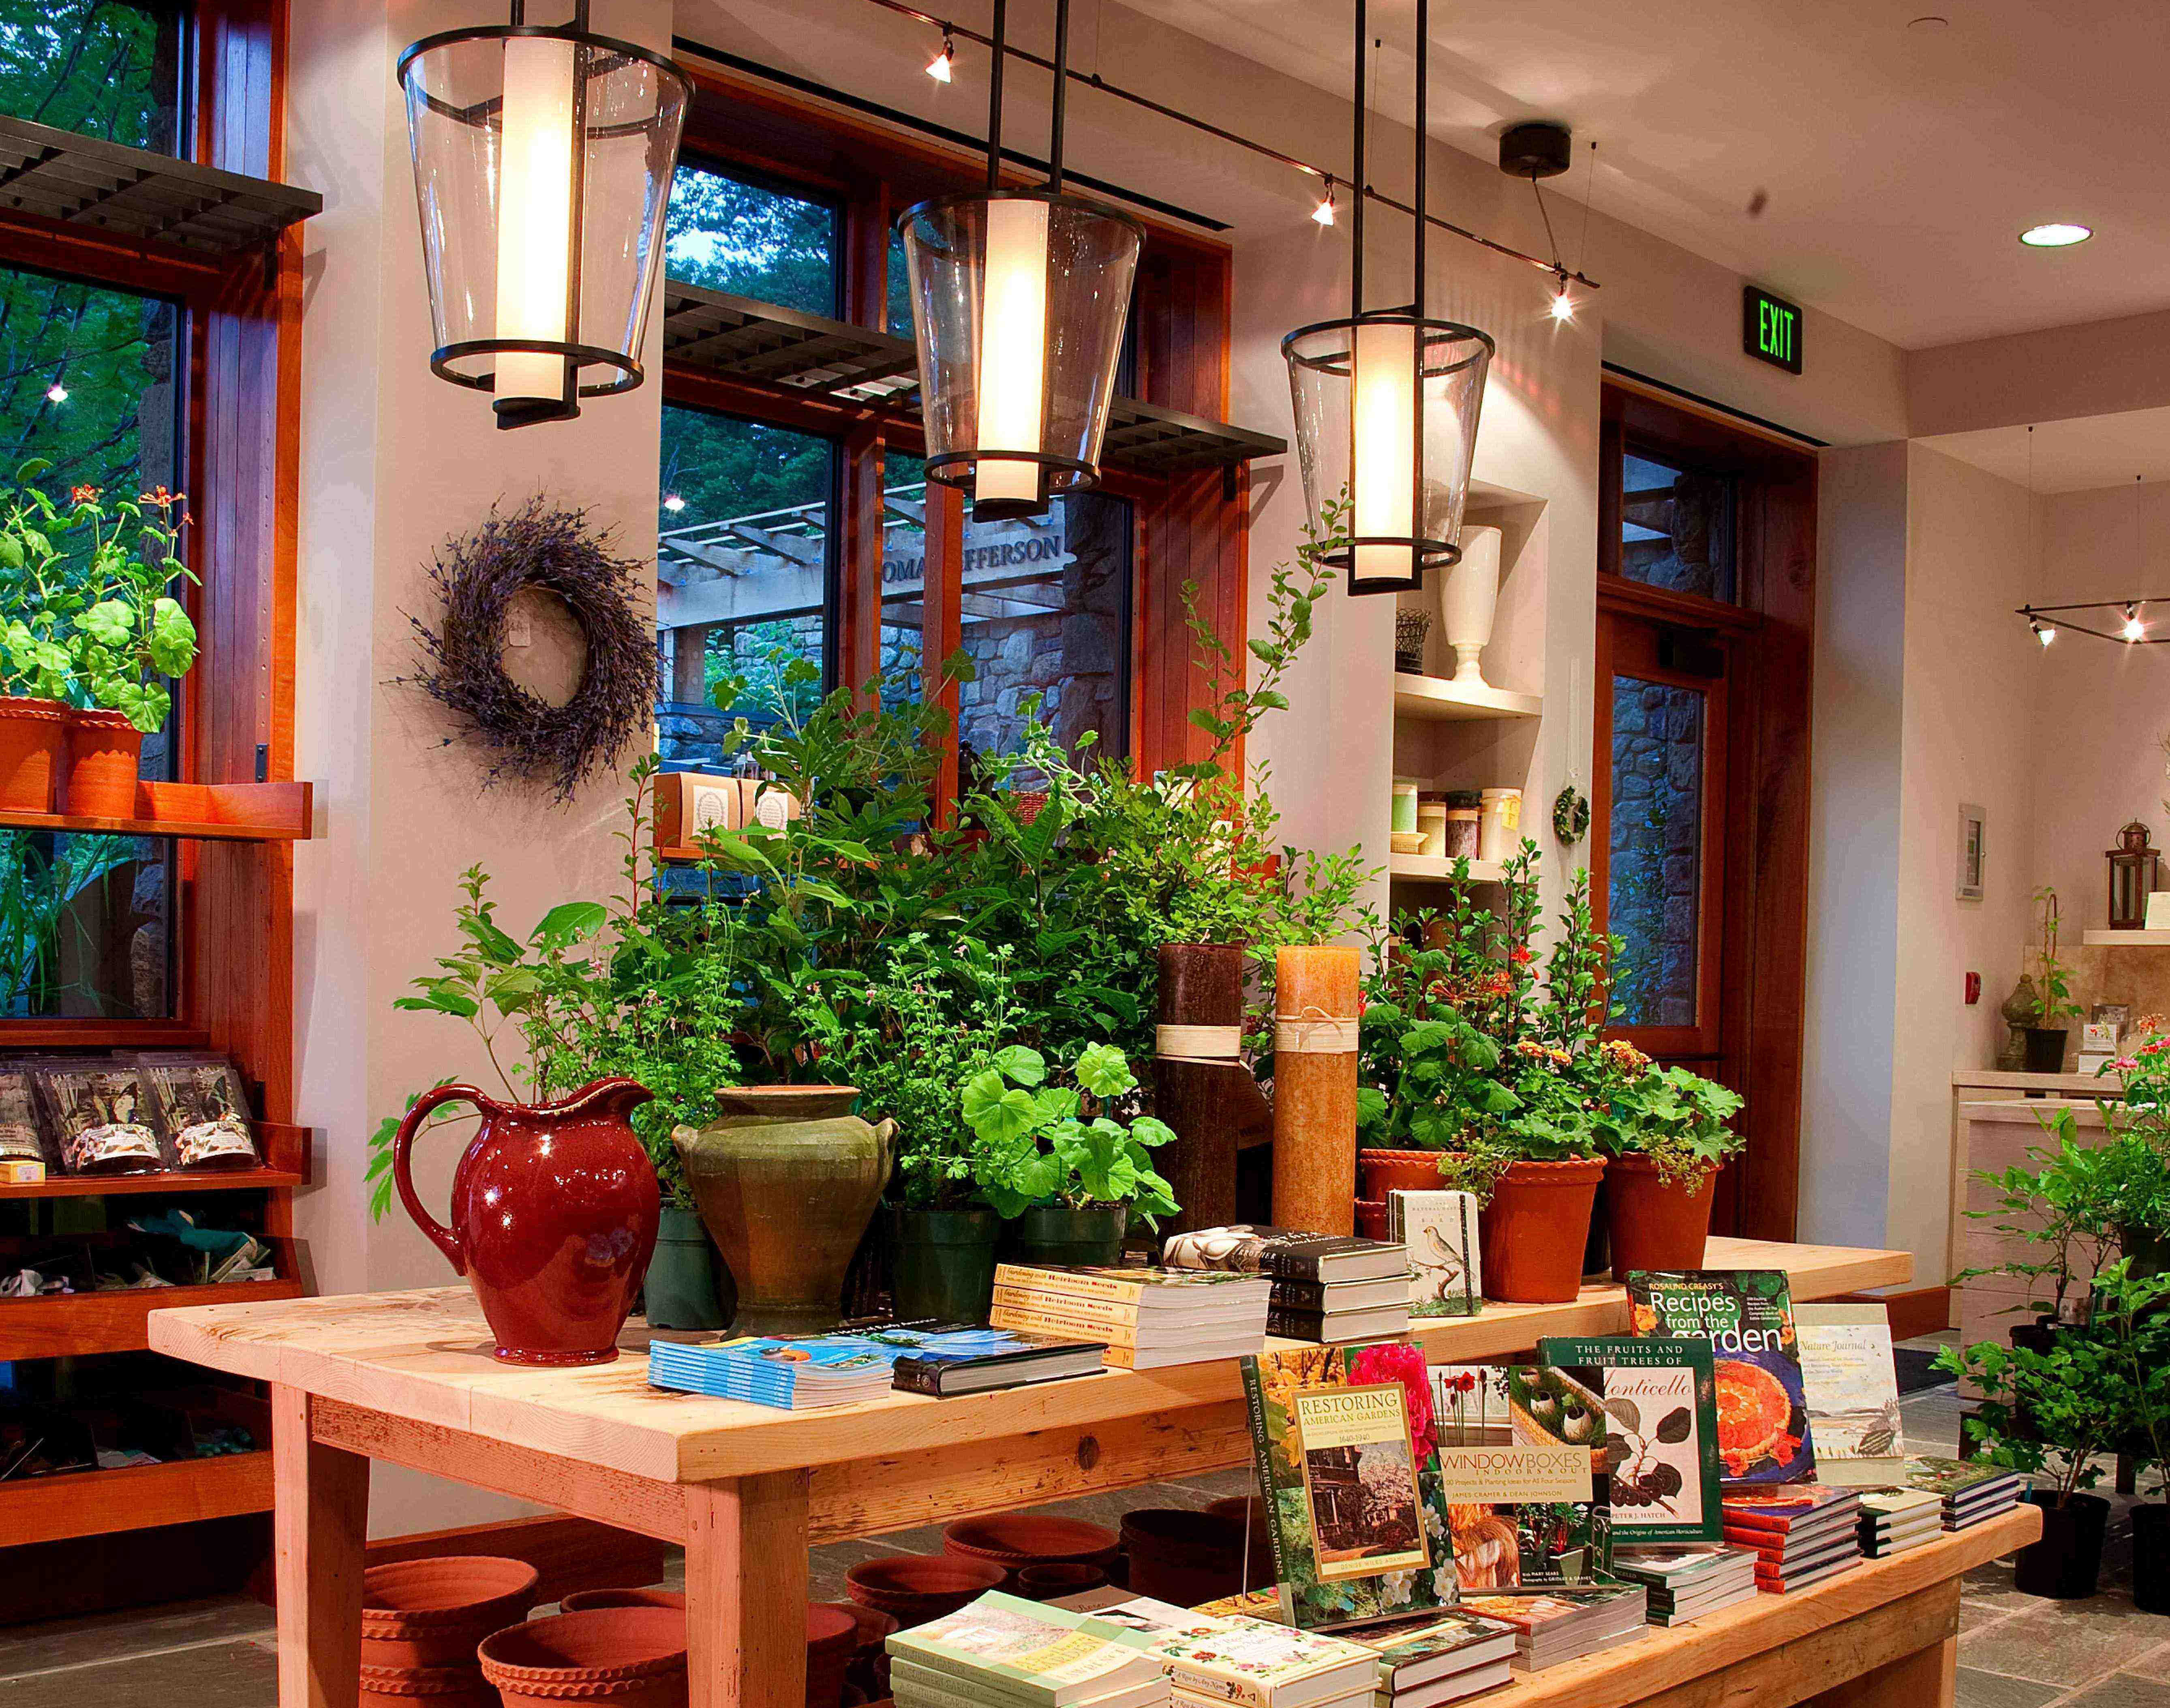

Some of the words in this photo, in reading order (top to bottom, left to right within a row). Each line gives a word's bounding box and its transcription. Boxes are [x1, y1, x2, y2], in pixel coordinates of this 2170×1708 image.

[1760, 299, 1793, 362] EXIT
[883, 556, 924, 584] OMA
[964, 535, 1061, 572] FFERSON
[1648, 1283, 1686, 1291] ROSALIND
[1650, 1291, 1736, 1318] Recipes
[1666, 1314, 1701, 1328] from
[1704, 1314, 1729, 1328] the
[1671, 1319, 1784, 1353] rden
[1800, 1340, 1830, 1351] Nature
[1832, 1339, 1867, 1352] Journal
[1575, 1345, 1601, 1354] THE
[1607, 1345, 1651, 1354] FRUITS
[1657, 1345, 1683, 1354] AND
[1578, 1357, 1616, 1365] FRUIT
[1621, 1357, 1661, 1365] TREES
[1666, 1357, 1682, 1365] OF
[1301, 1393, 1397, 1415] RESTORING
[1303, 1413, 1354, 1426] AMERICAN
[1357, 1408, 1400, 1421] GARDENS
[1248, 1379, 1265, 1443] RESTORING
[1259, 1449, 1275, 1514] AMERICAN
[1270, 1519, 1284, 1575] GARDENS
